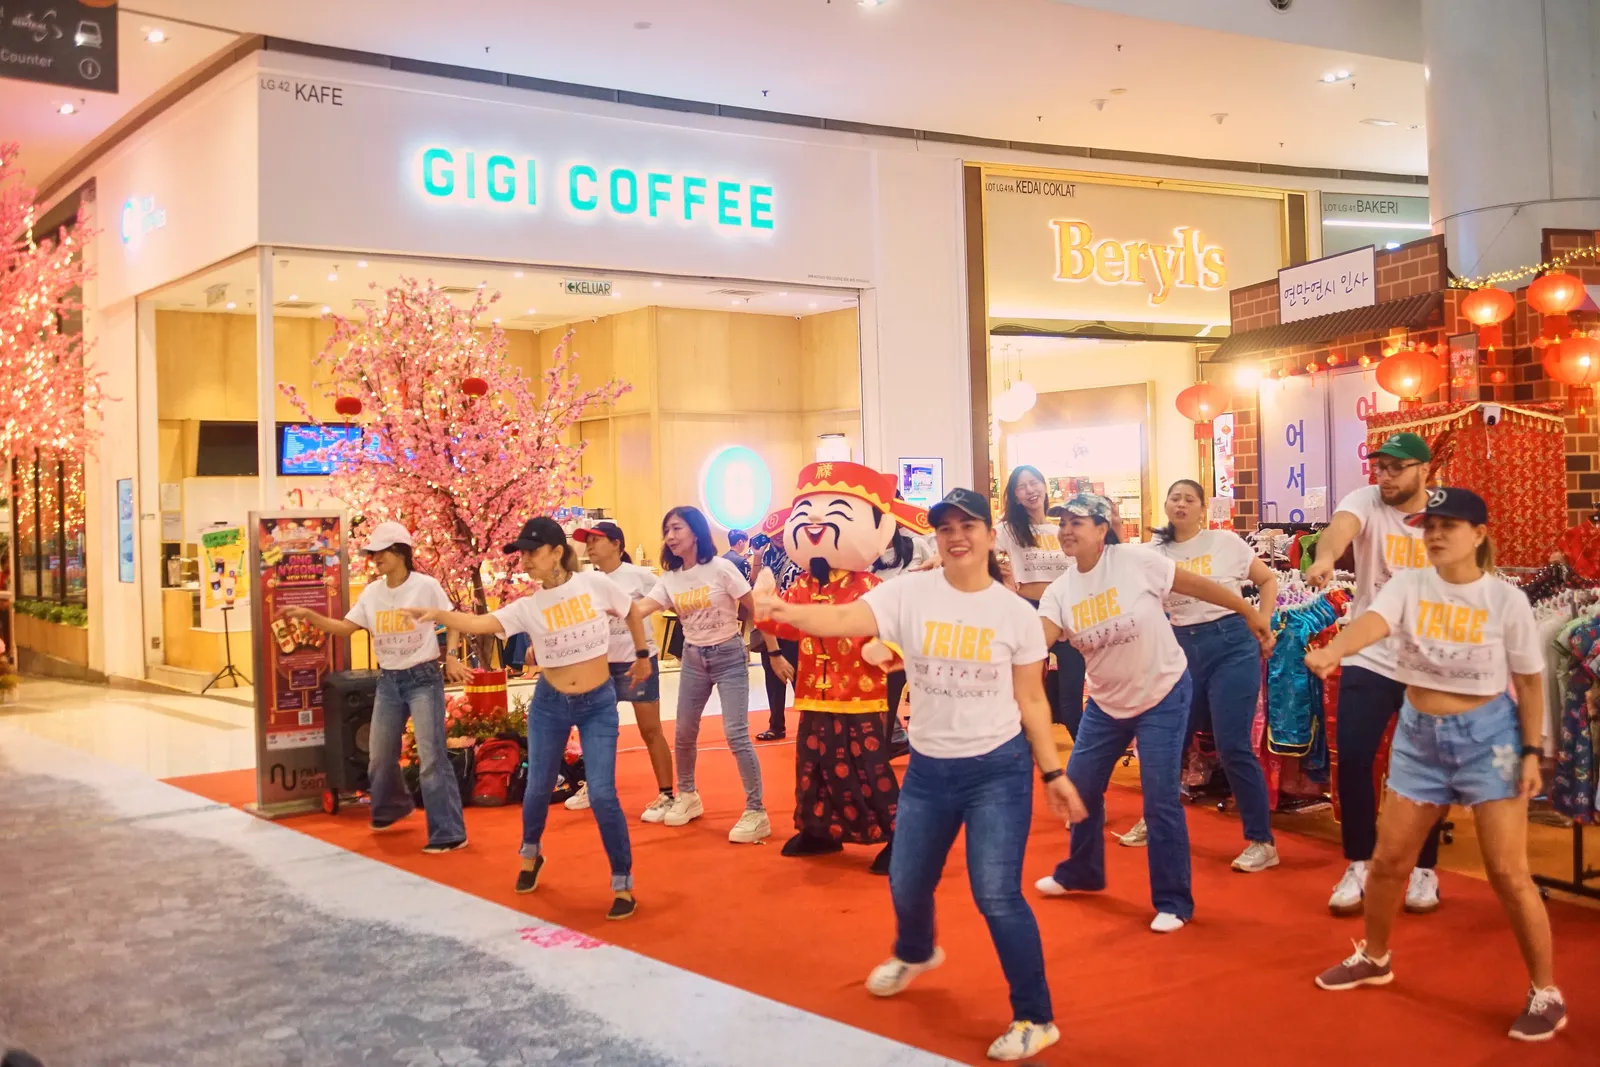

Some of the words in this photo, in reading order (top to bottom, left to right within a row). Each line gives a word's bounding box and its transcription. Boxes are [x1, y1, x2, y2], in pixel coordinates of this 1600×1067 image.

[0, 49, 52, 67] Counter
[261, 79, 275, 90] LG
[278, 81, 290, 92] 42
[295, 83, 343, 106] KAFE
[423, 148, 536, 205] GIGI
[569, 165, 774, 229] COFFEE
[985, 182, 996, 191] LOT
[996, 183, 1004, 192] LG
[1015, 180, 1041, 194] KEDAI
[1043, 182, 1076, 197] COKLAT
[1324, 203, 1337, 212] LOT
[1338, 204, 1347, 212] LG
[1357, 200, 1398, 214] BAKERI
[1052, 220, 1228, 305] Beryl's
[575, 282, 611, 294] KELUAR
[1284, 278, 1336, 307] 연말연시
[1340, 271, 1368, 294] 인사
[542, 593, 597, 633] TRIBE
[1072, 587, 1121, 633] TRIBE
[1416, 600, 1488, 645] TRIBE
[922, 621, 995, 662] TRIBE
[300, 778, 325, 790] sen
